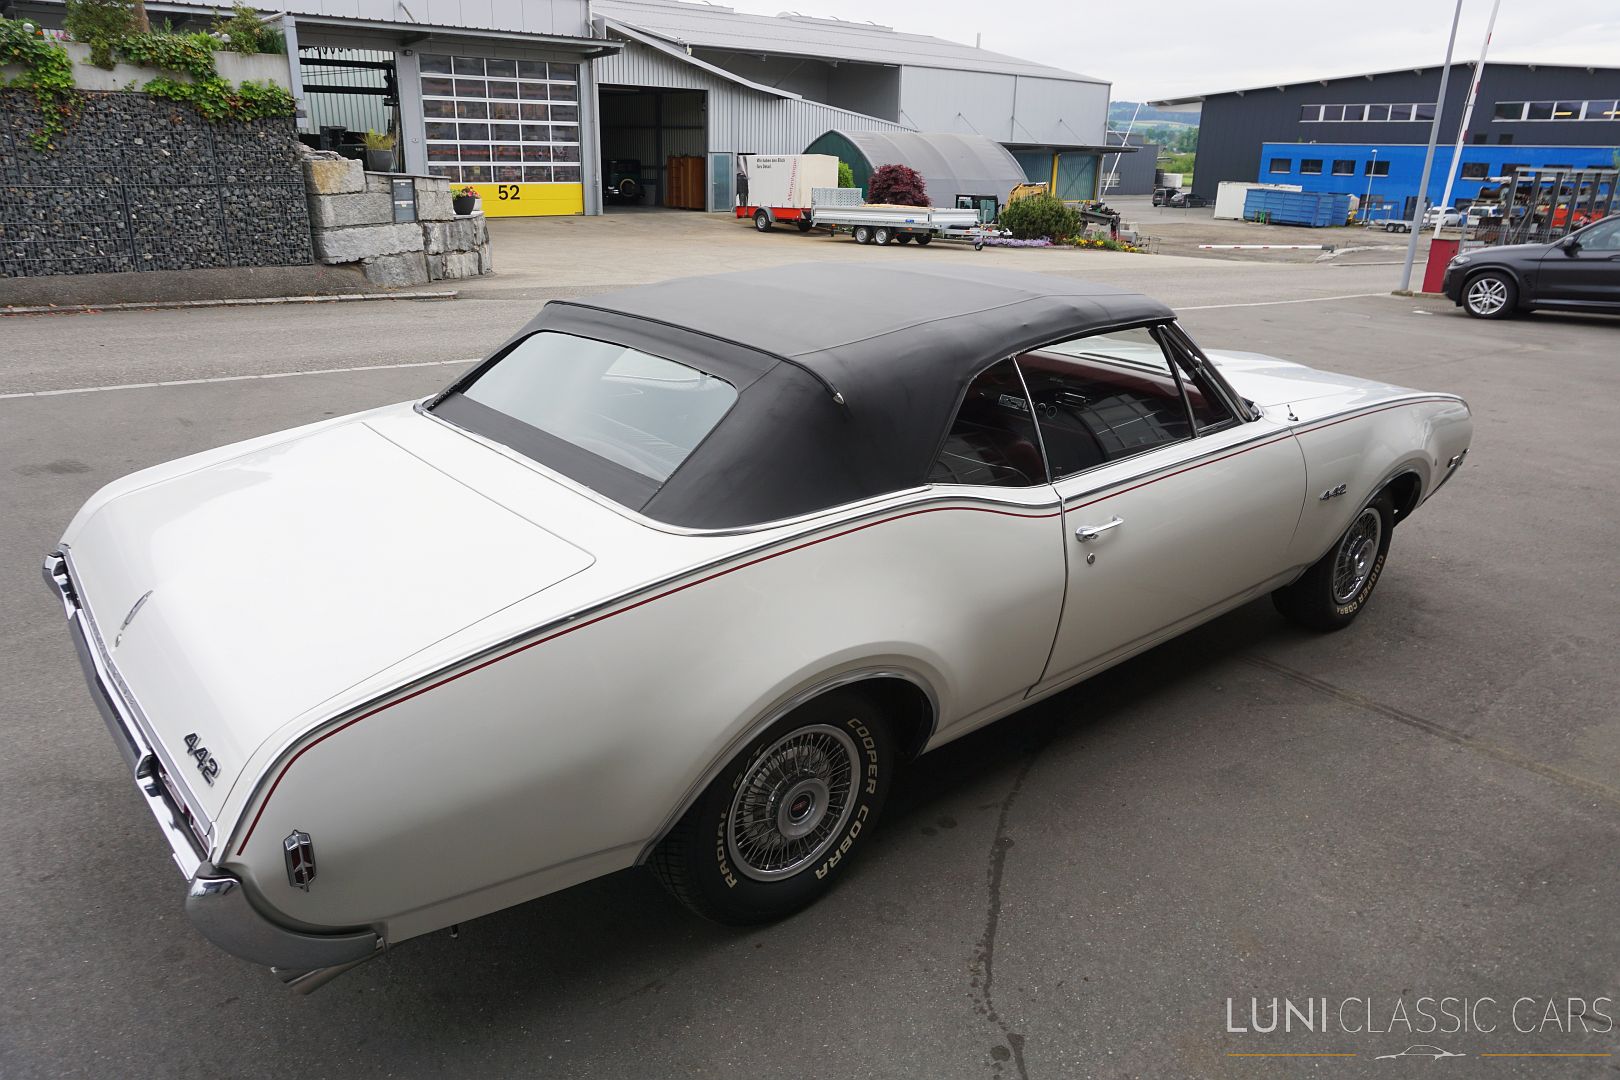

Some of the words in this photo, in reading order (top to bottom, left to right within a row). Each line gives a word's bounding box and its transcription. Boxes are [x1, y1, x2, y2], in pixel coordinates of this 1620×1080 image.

[498, 184, 521, 200] 52
[183, 732, 221, 787] 442
[847, 718, 878, 795] COOPER
[815, 804, 869, 880] COBRA
